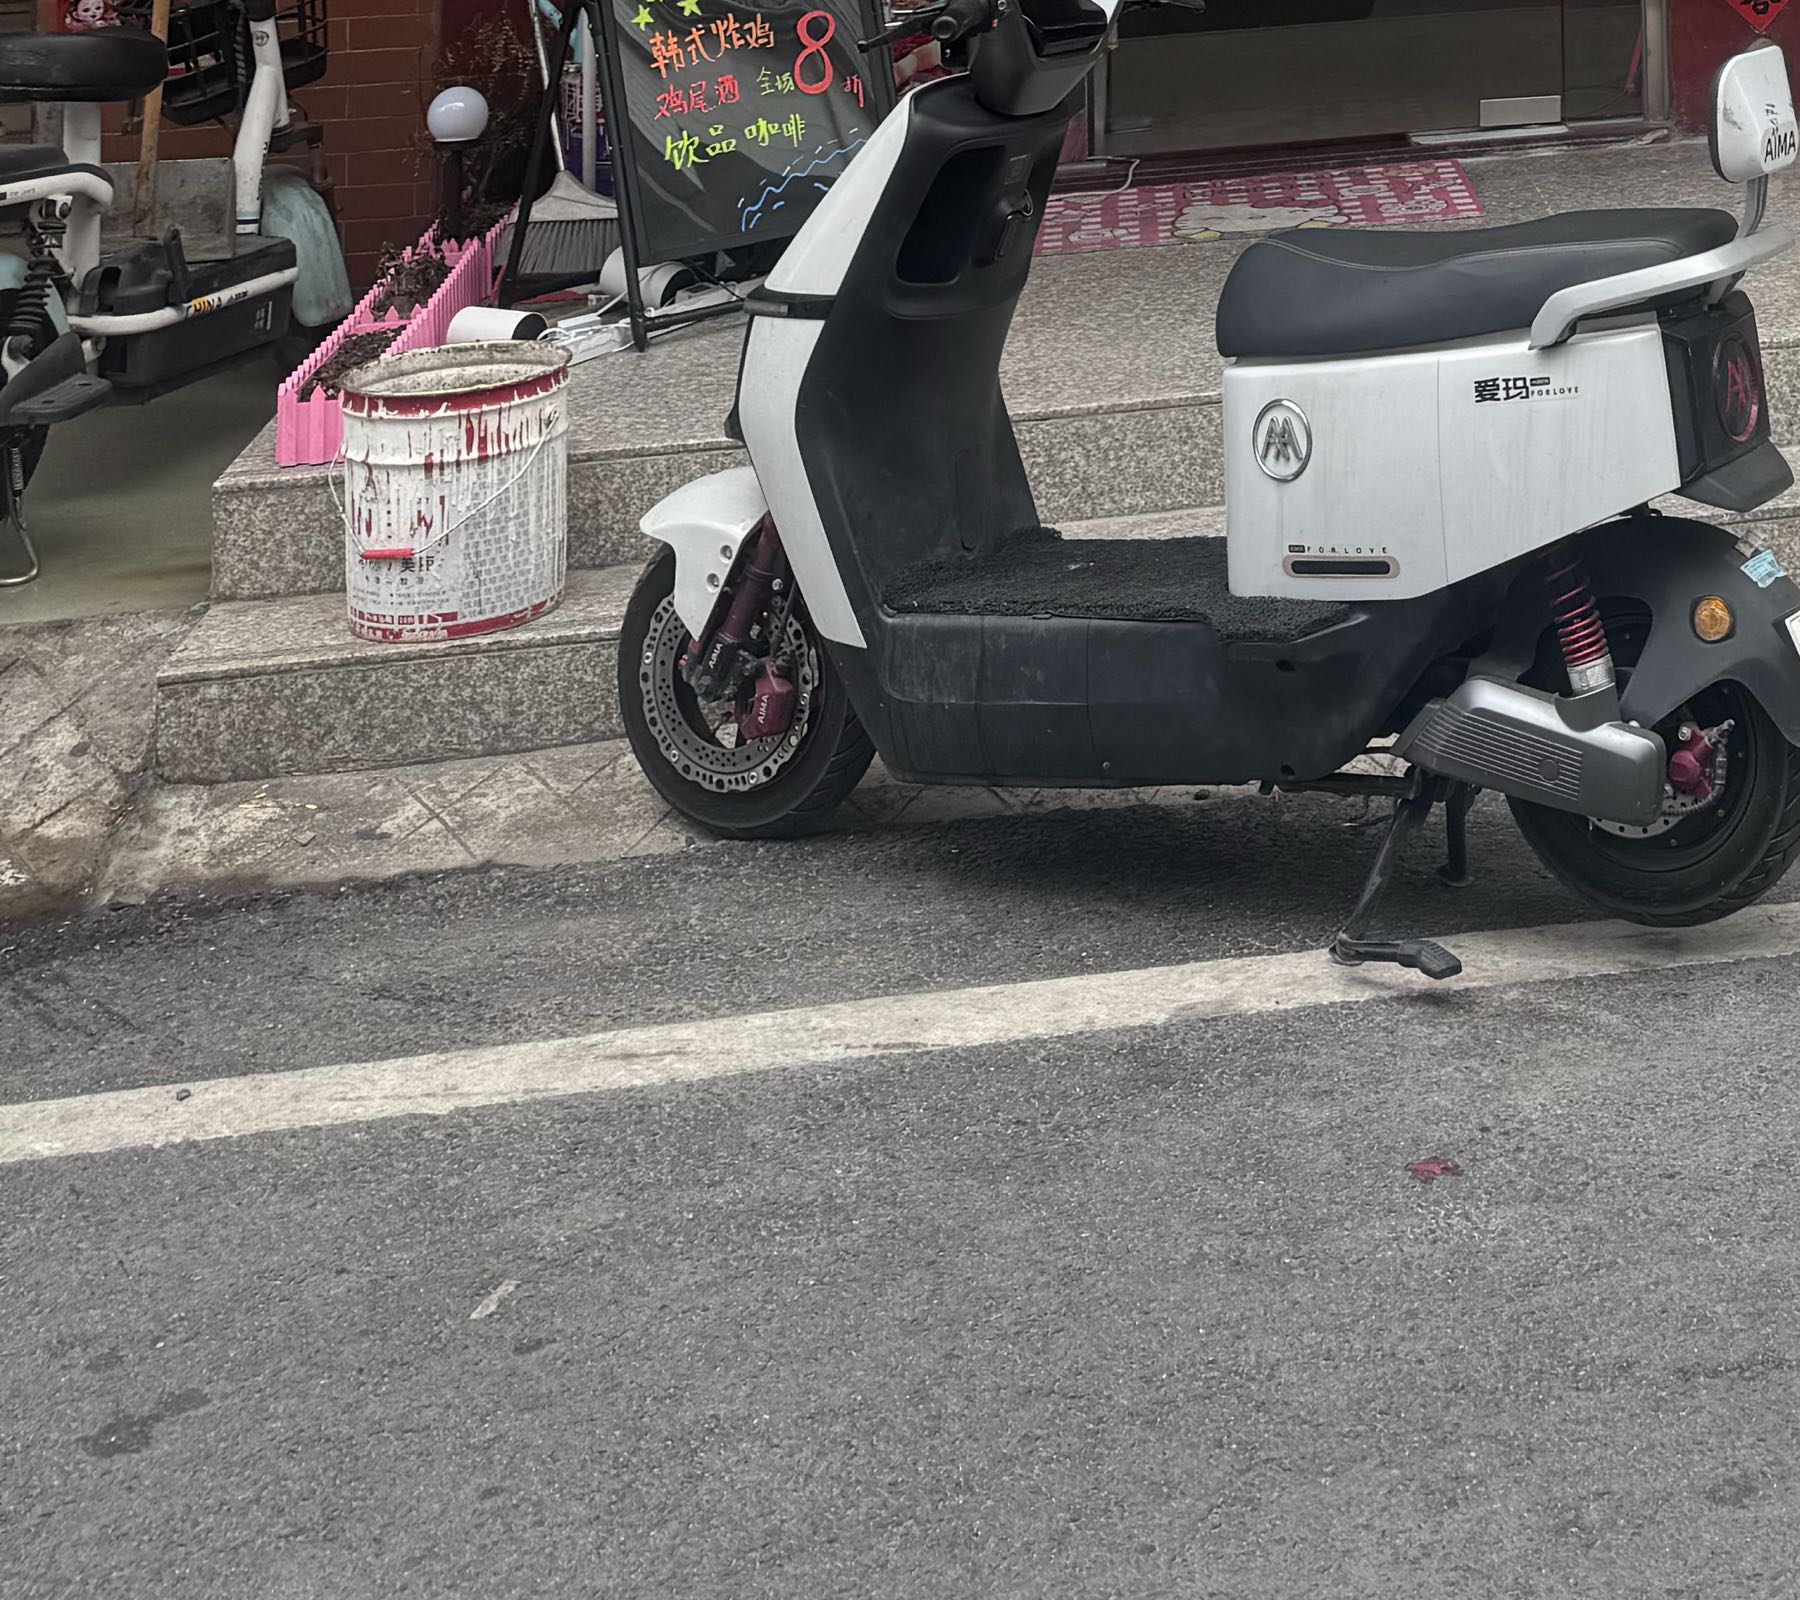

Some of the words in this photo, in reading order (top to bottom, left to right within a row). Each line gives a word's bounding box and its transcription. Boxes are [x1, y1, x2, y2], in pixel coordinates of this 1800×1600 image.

[648, 12, 776, 78] 韩式炸鸡
[756, 66, 794, 96] 全场
[793, 10, 836, 95] 8
[843, 75, 865, 108] 折
[653, 72, 741, 121] 鸡尾酒
[663, 123, 737, 170] 饮品
[744, 113, 807, 149] 咖啡
[1764, 130, 1797, 164] AIMA
[1473, 377, 1530, 403] 爱玛
